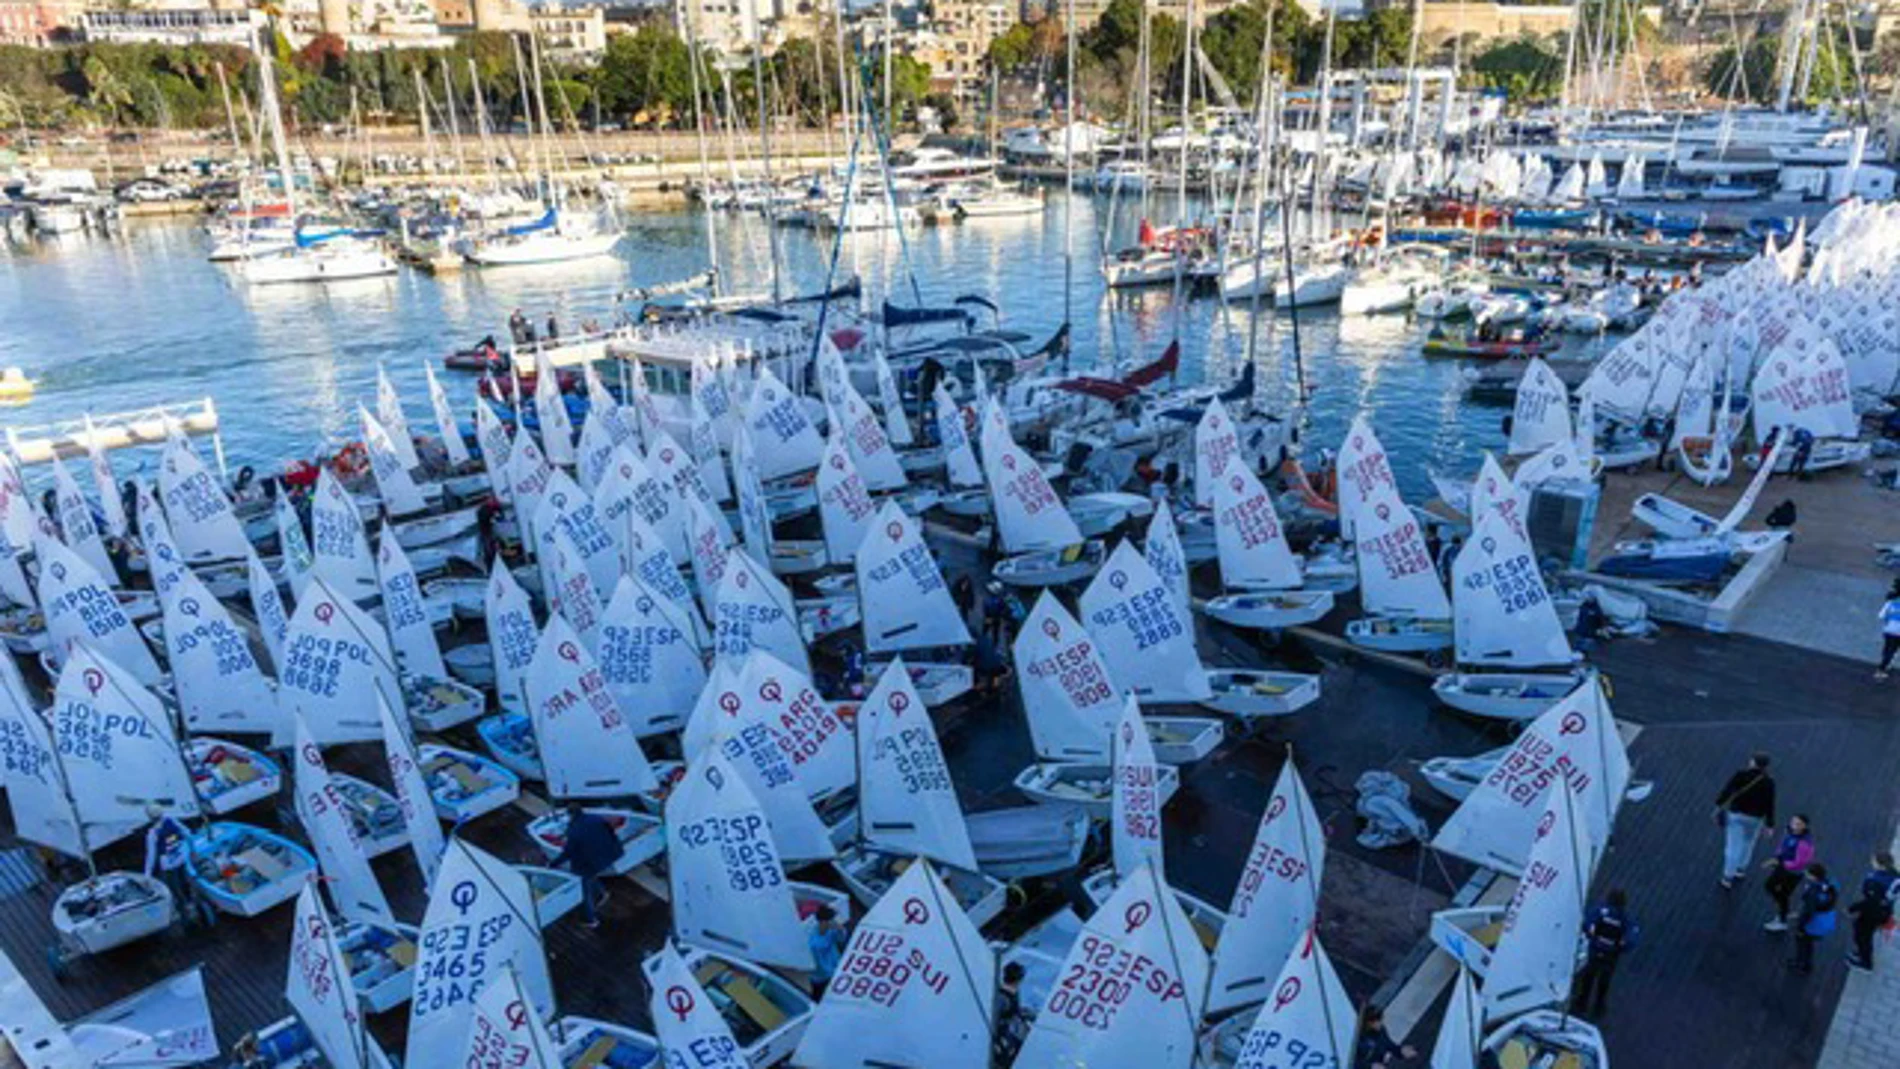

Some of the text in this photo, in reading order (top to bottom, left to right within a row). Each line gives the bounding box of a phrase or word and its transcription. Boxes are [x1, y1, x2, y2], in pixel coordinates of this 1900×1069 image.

[1130, 586, 1164, 612] ESP
[334, 639, 374, 666] POL
[780, 688, 816, 730] ARG
[104, 714, 153, 739] POL
[842, 953, 911, 987] 1980
[906, 948, 950, 995] SUI
[1128, 953, 1185, 1003] ESP
